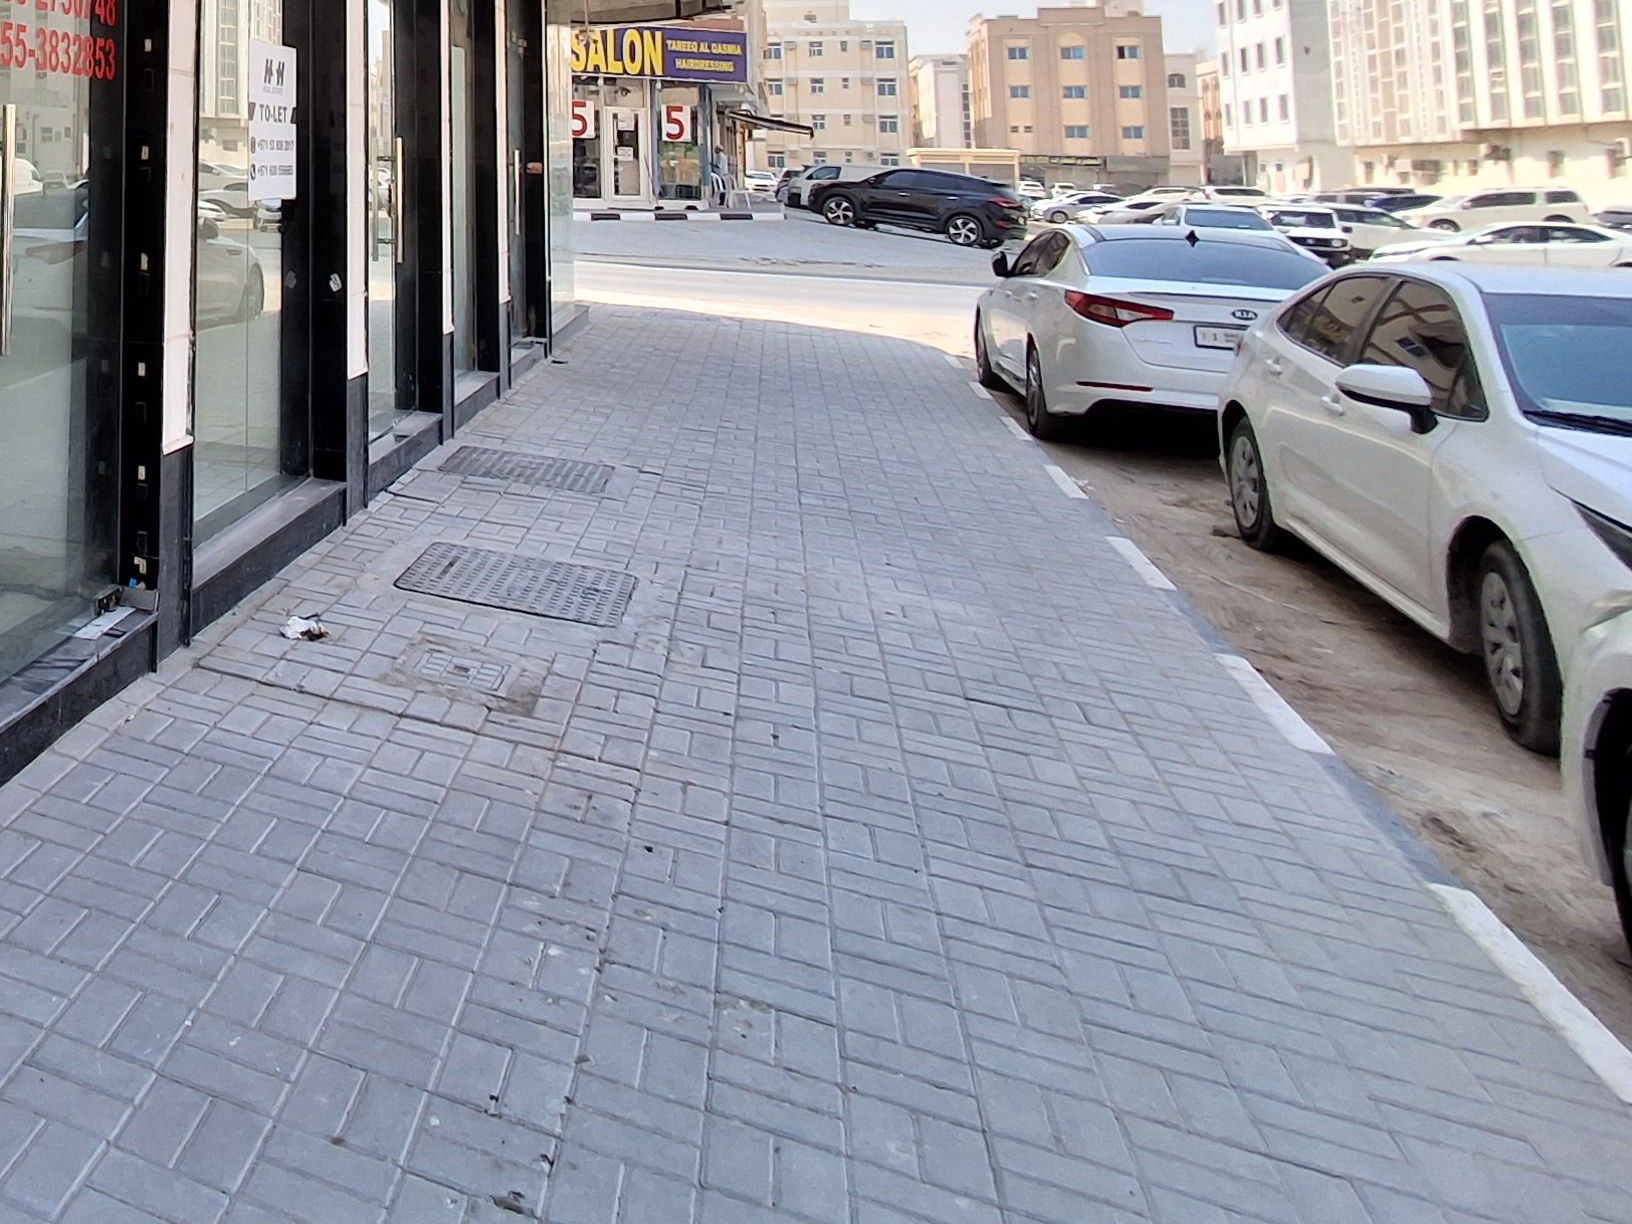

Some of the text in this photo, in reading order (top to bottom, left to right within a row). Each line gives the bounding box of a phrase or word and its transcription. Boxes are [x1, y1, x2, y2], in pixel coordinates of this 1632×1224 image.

[571, 28, 663, 76] SALON
[699, 42, 710, 53] AL
[675, 58, 734, 72] HAIRDRESSING
[259, 104, 287, 123] TO-LET
[572, 101, 588, 137] 5
[666, 105, 685, 140] 5
[1235, 311, 1255, 320] KIA
